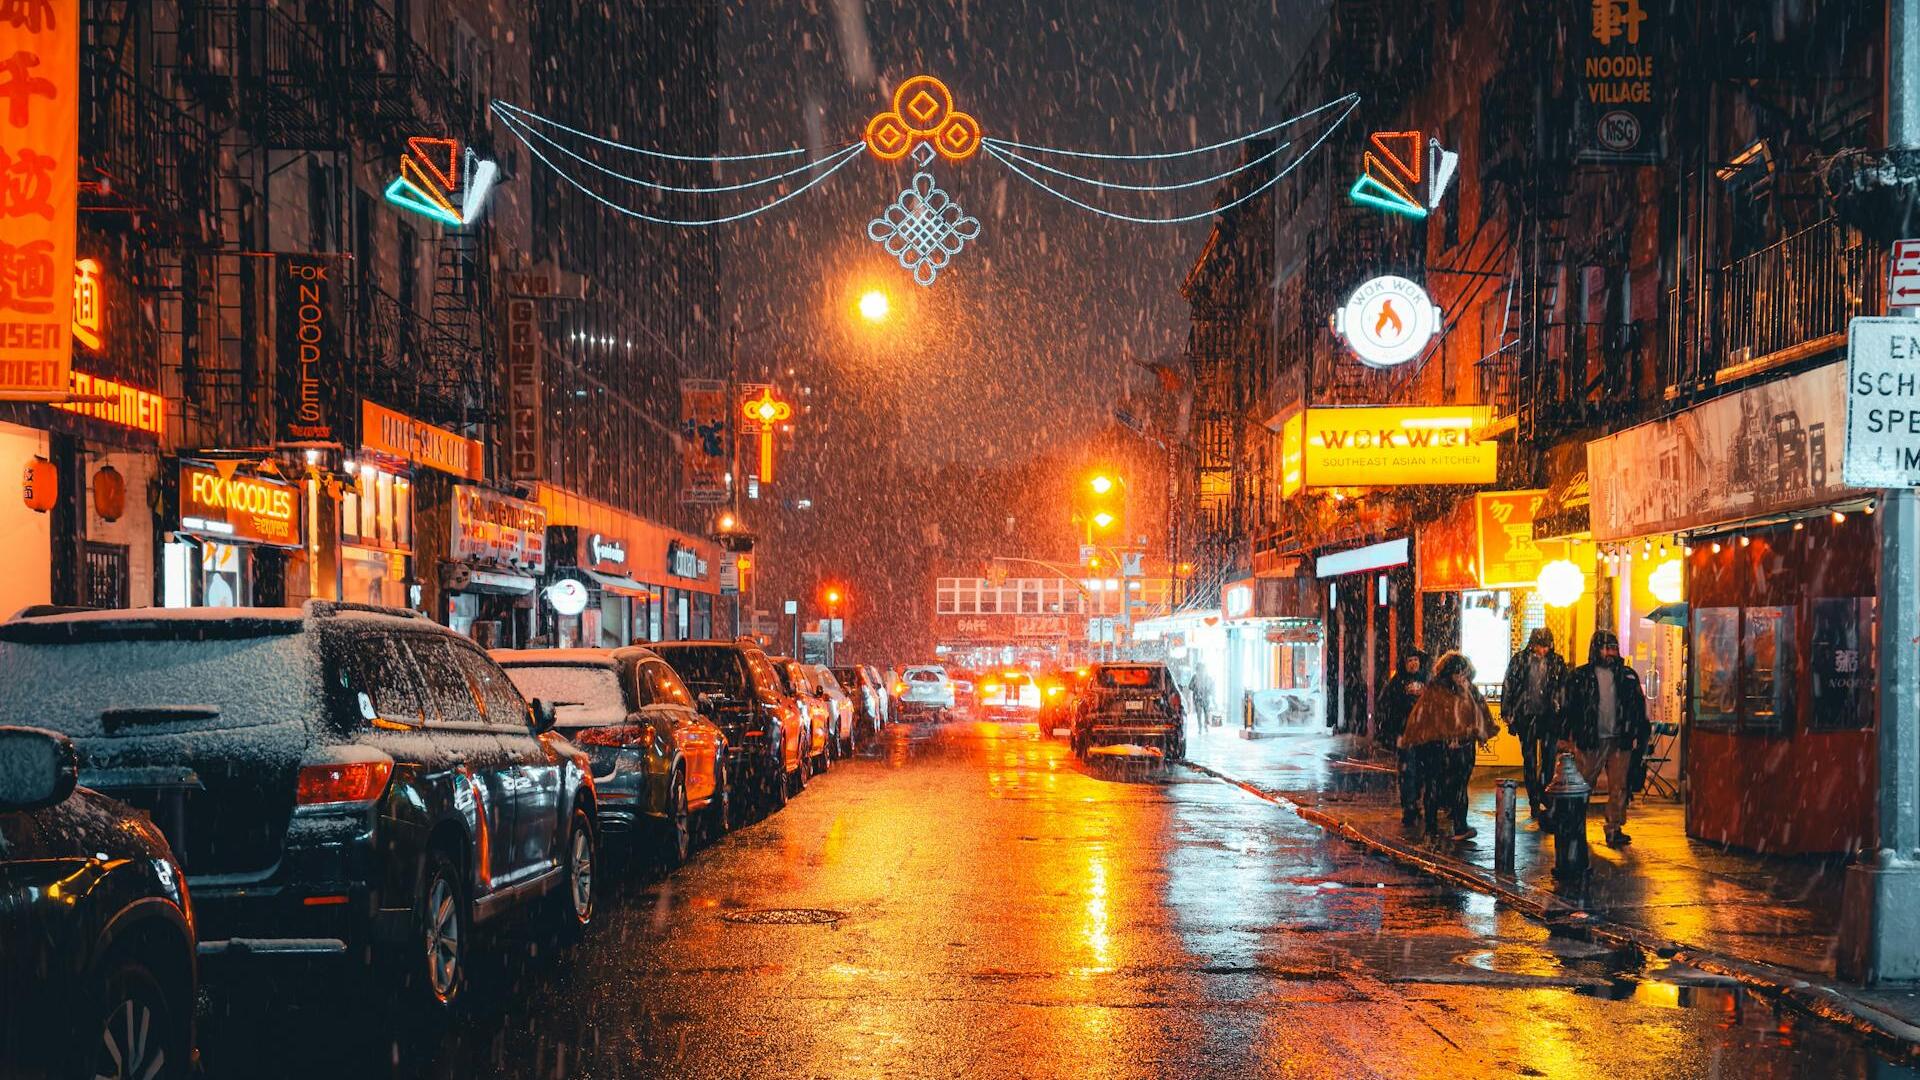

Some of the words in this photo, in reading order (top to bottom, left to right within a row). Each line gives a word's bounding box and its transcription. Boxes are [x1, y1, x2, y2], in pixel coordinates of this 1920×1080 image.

[1585, 56, 1653, 78] NOODLE
[1588, 82, 1651, 103] VILLAGE
[1606, 120, 1634, 141] MSG
[289, 265, 329, 281] FOK
[1353, 280, 1385, 306] WOK
[1392, 279, 1424, 304] WOK
[299, 285, 323, 422] NOODLES
[1857, 371, 1920, 397] SCH
[1320, 430, 1395, 449] WOK
[1405, 428, 1481, 448] WOK
[1322, 457, 1387, 467] SOUTHEAST
[1392, 456, 1426, 466] ASIAN
[1431, 455, 1481, 465] KITCHEN
[192, 472, 224, 508] FOK
[226, 480, 291, 520] NOODLES
[260, 517, 289, 539] express
